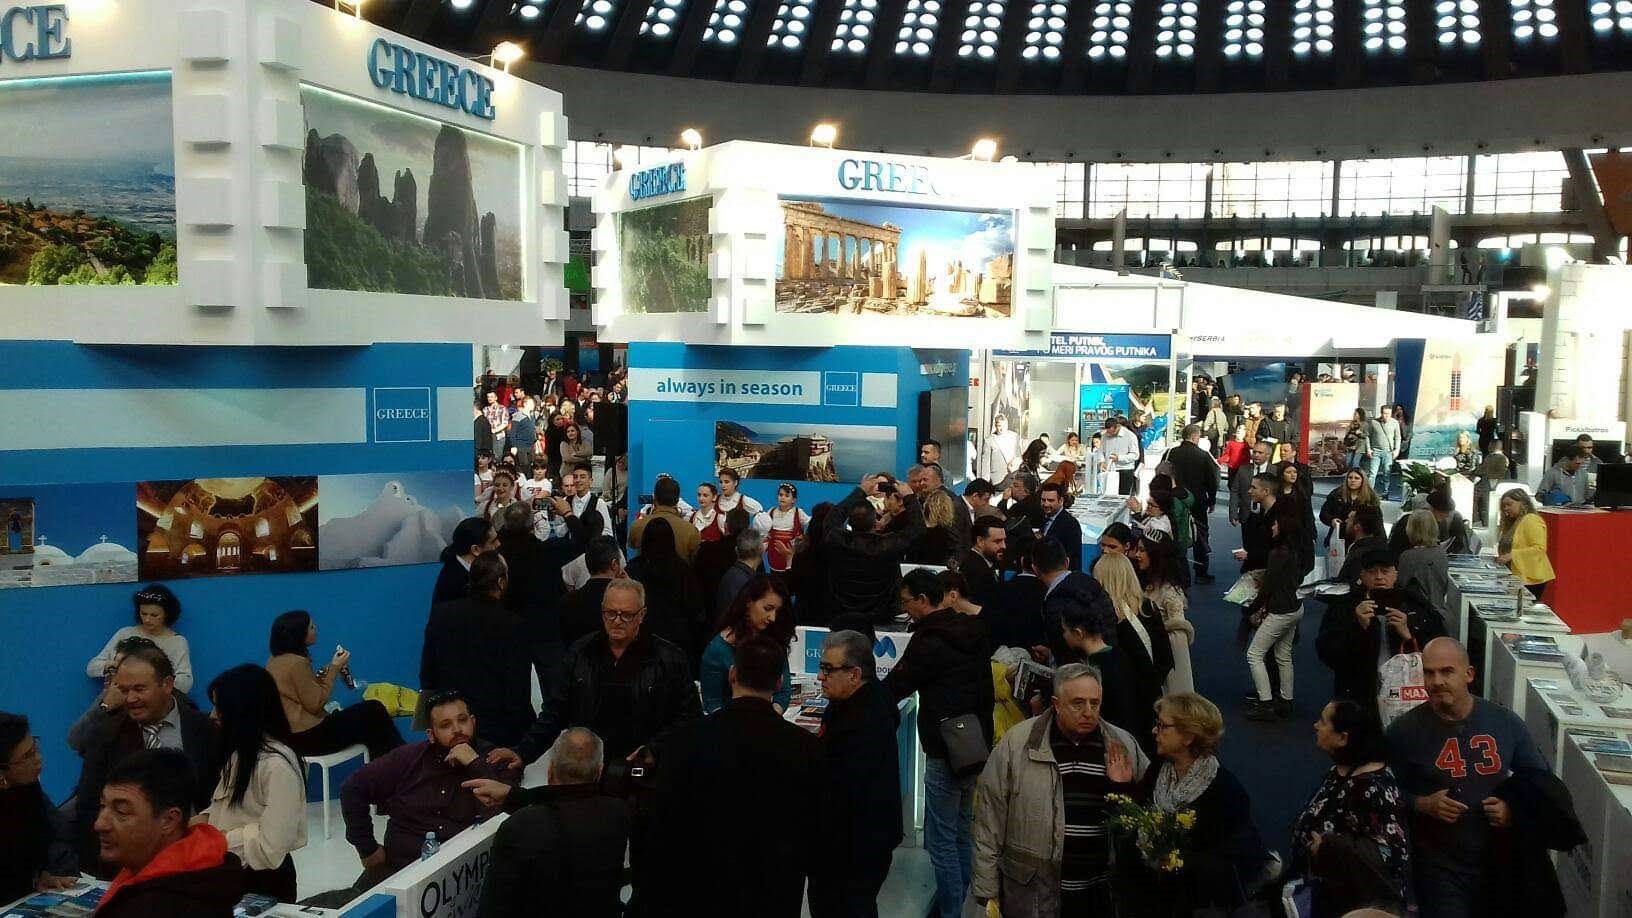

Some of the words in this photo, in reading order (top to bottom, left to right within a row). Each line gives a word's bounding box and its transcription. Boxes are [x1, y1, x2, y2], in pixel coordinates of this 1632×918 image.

[0, 4, 71, 61] CE
[367, 38, 496, 120] GREECE
[629, 161, 688, 201] GREECE
[1050, 335, 1067, 345] TEL
[1051, 345, 1073, 355] MERI
[1075, 345, 1114, 356] PRAVOG
[1115, 346, 1157, 356] PUTNIKA
[656, 378, 715, 397] always
[720, 379, 736, 395] in
[740, 382, 803, 396] season
[826, 384, 856, 392] GREECE
[377, 408, 429, 419] GREECE
[806, 648, 825, 658] GR
[1435, 734, 1502, 777] 43
[421, 849, 493, 918] OLYMP
